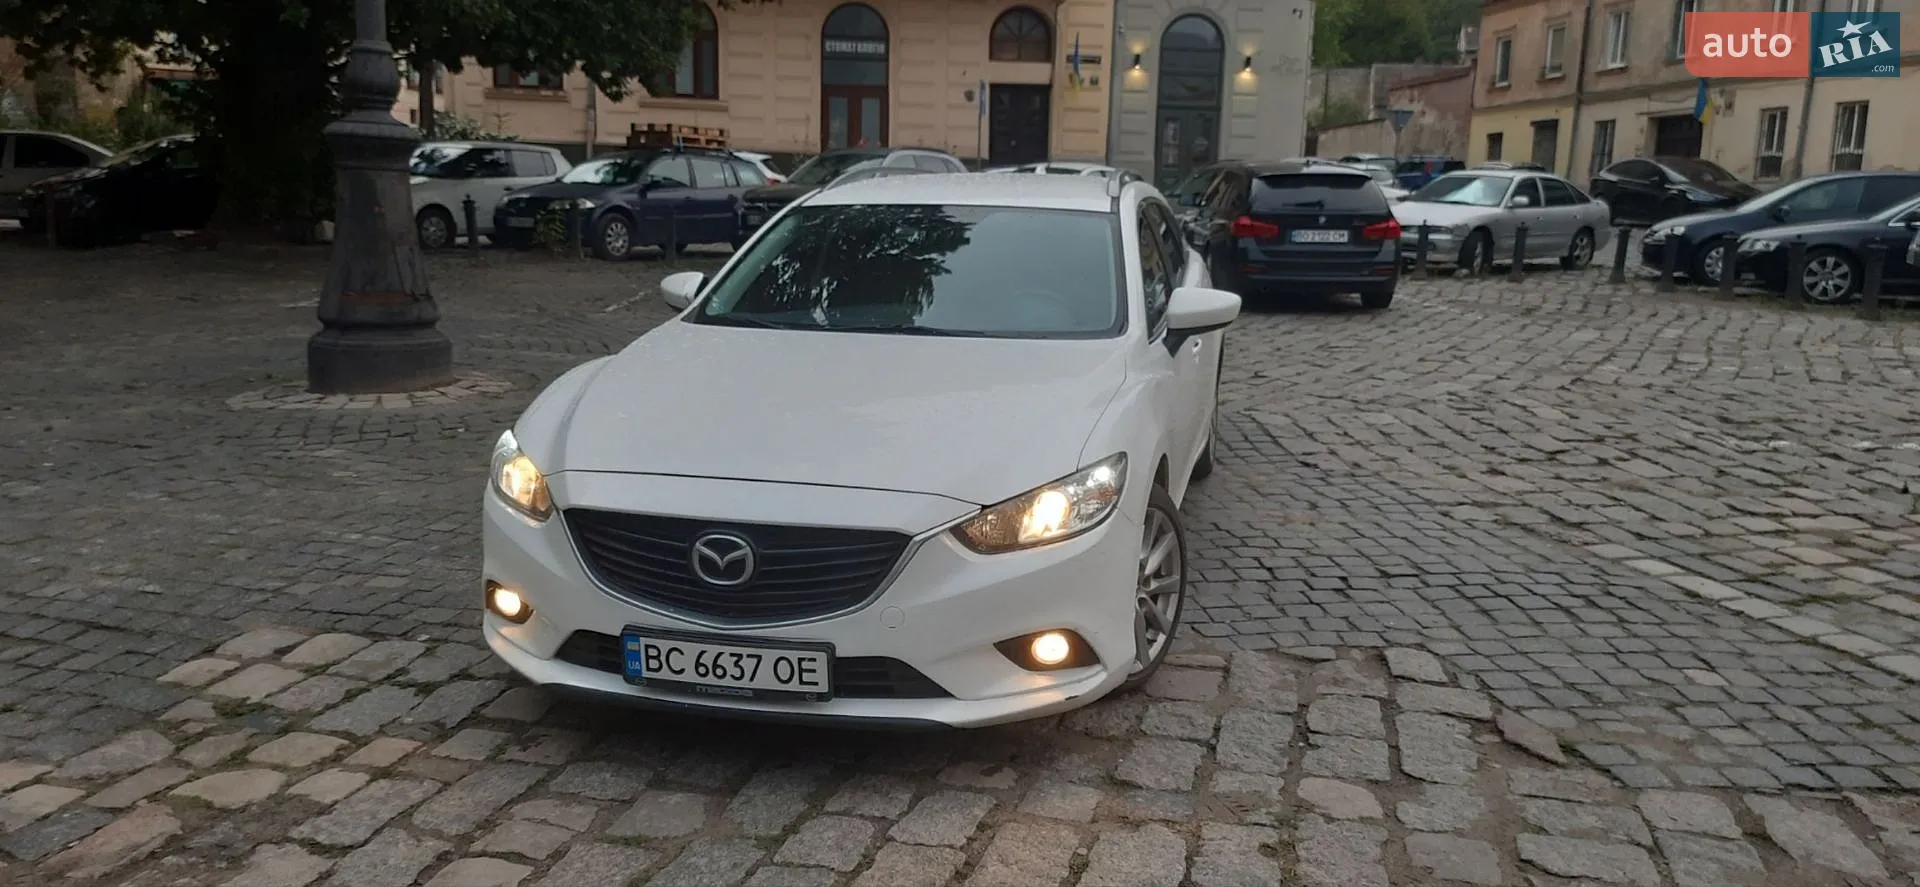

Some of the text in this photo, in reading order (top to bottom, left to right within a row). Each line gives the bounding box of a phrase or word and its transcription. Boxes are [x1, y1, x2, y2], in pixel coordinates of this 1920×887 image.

[628, 660, 641, 671] UA
[644, 644, 819, 686] BC 6637 OE
